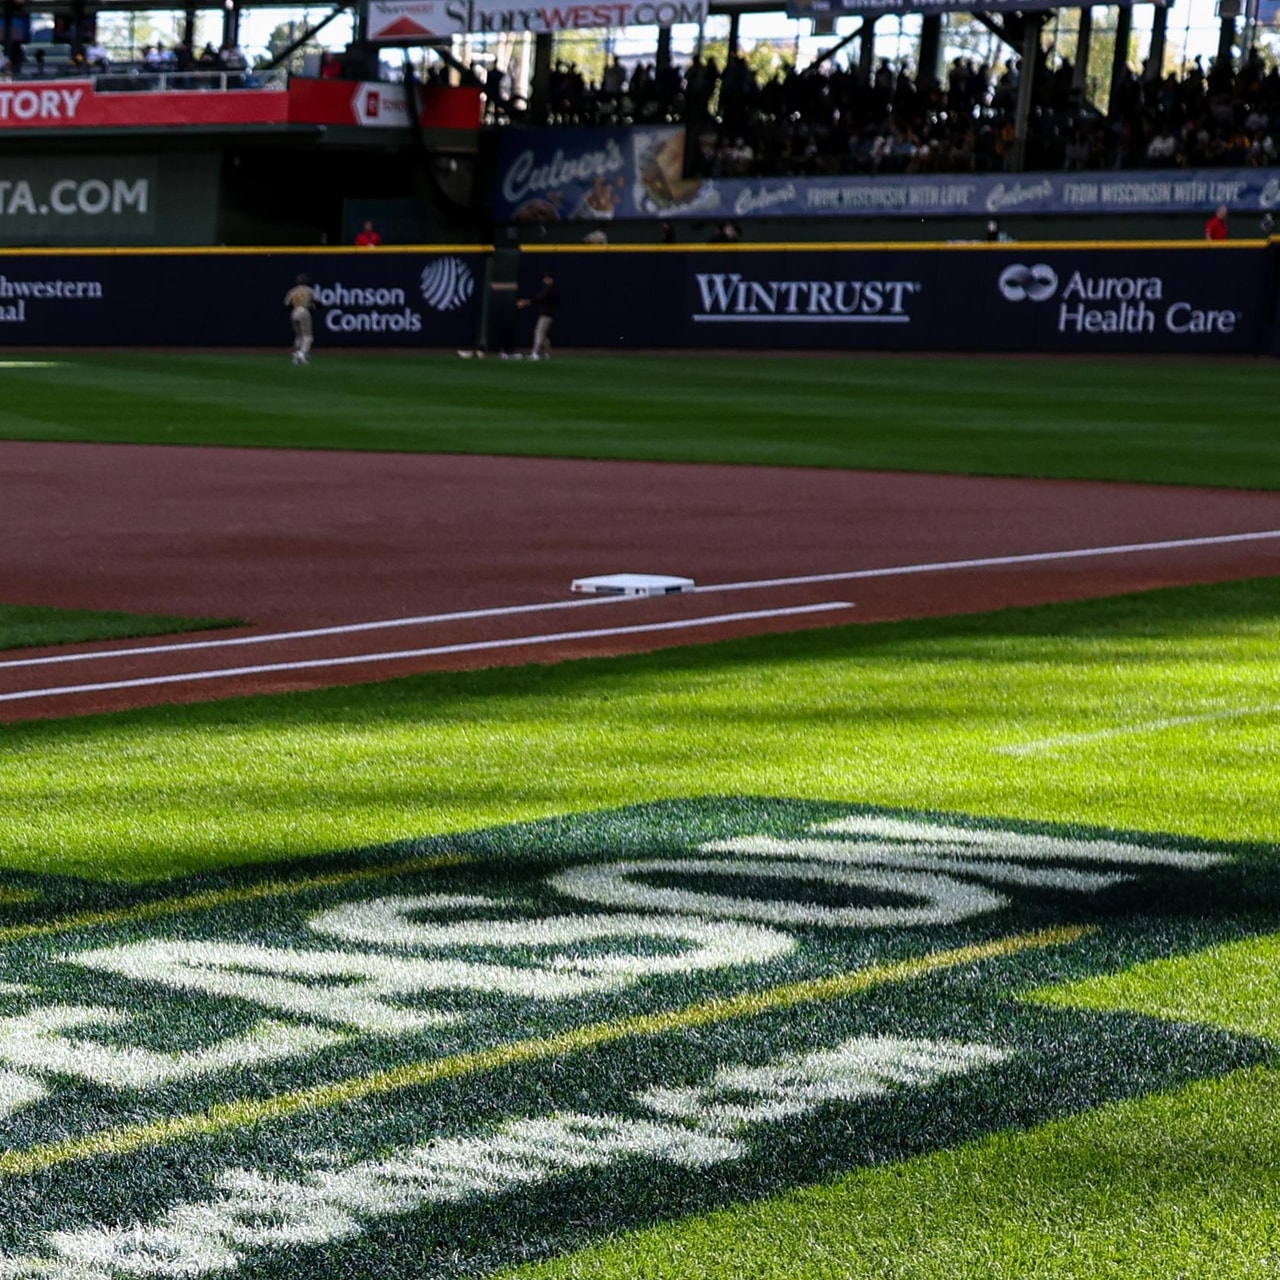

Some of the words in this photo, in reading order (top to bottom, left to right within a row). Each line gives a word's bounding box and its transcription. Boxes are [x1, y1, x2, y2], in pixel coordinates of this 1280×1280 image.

[1064, 182, 1098, 204] FROM
[1101, 182, 1171, 204] WISCONSIN
[1174, 181, 1207, 203] WITH
[1209, 180, 1241, 202] LOVE
[695, 273, 915, 314] WINTRUST
[1062, 269, 1163, 300] Aurora
[325, 307, 423, 332] Controls
[1058, 300, 1155, 333] Health
[1166, 302, 1236, 333] Care
